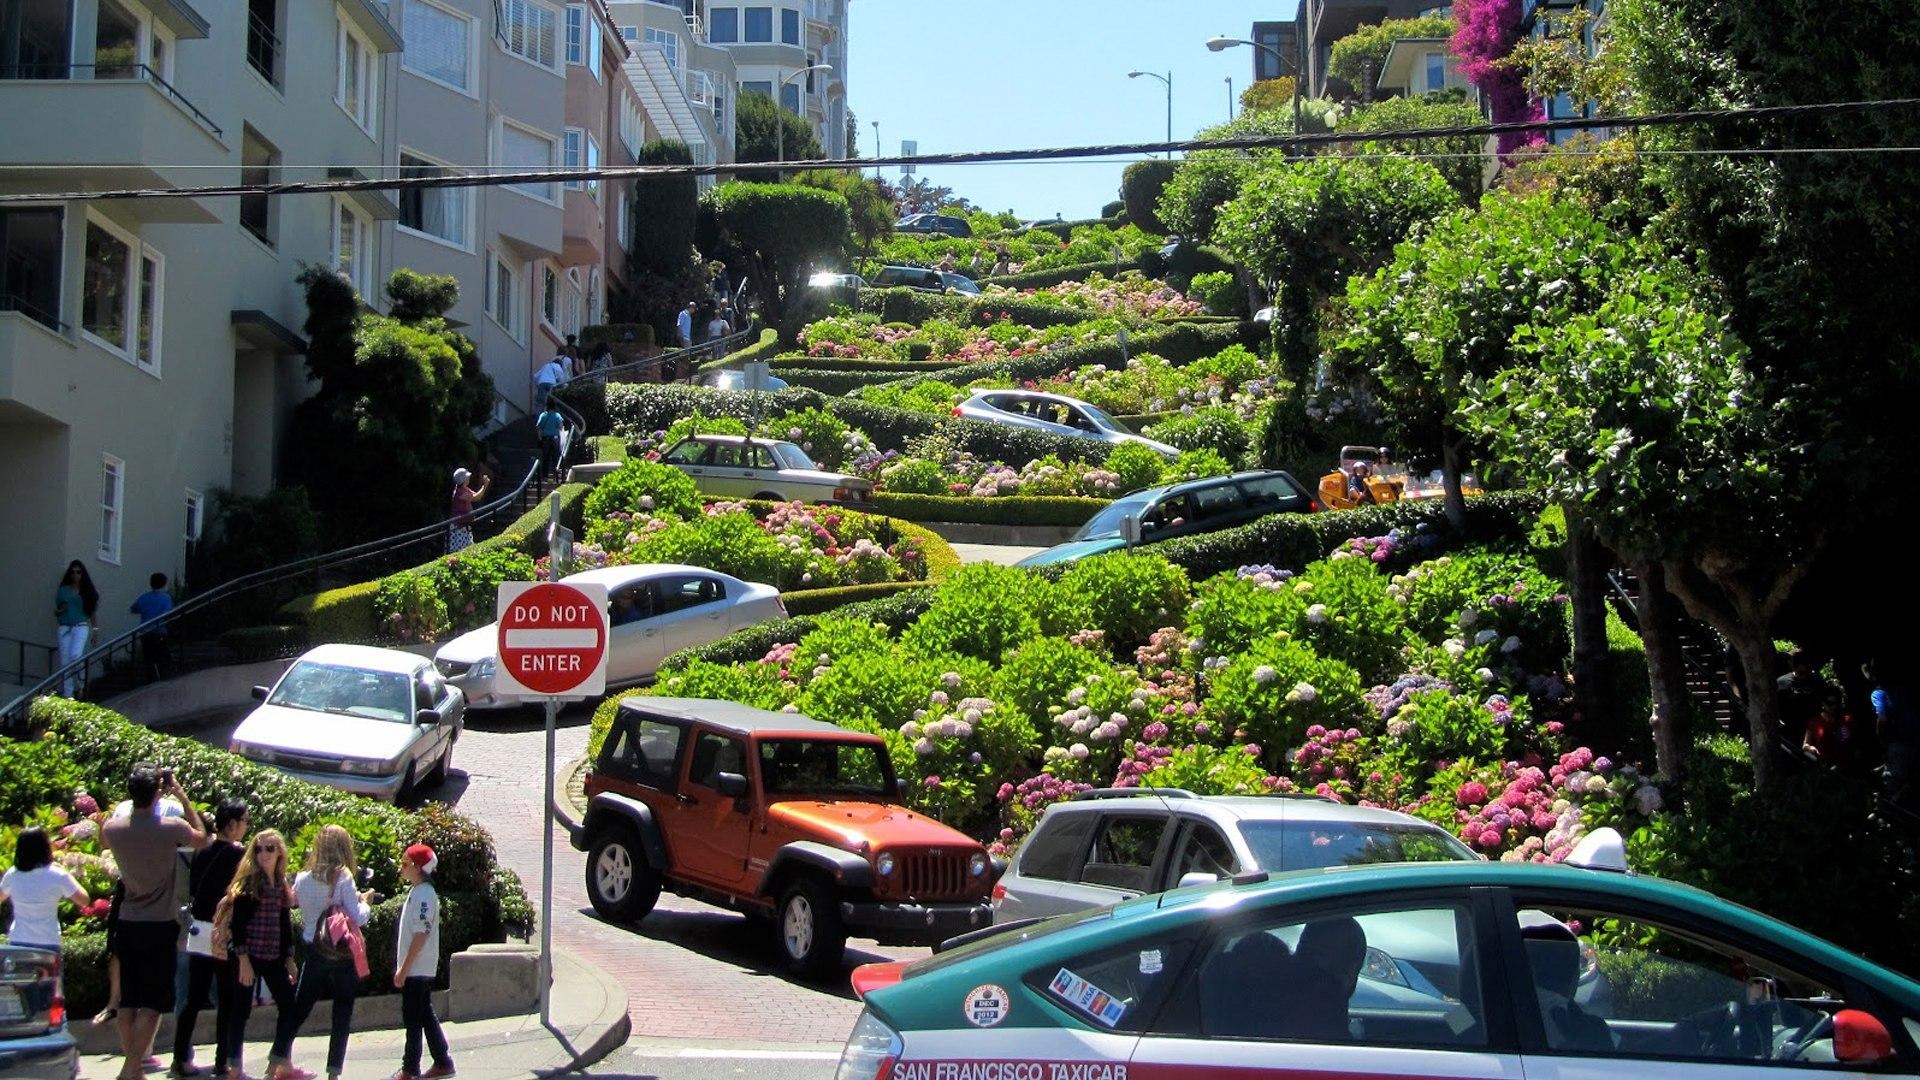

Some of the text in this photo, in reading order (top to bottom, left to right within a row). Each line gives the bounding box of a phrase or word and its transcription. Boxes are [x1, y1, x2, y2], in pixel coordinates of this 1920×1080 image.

[514, 605, 589, 623] DO NOT
[521, 654, 581, 671] ENTER
[1081, 986, 1097, 1005] VISA
[977, 1011, 995, 1019] 2012
[893, 1062, 1128, 1080] SAN FRANCISCO TAXICAB
